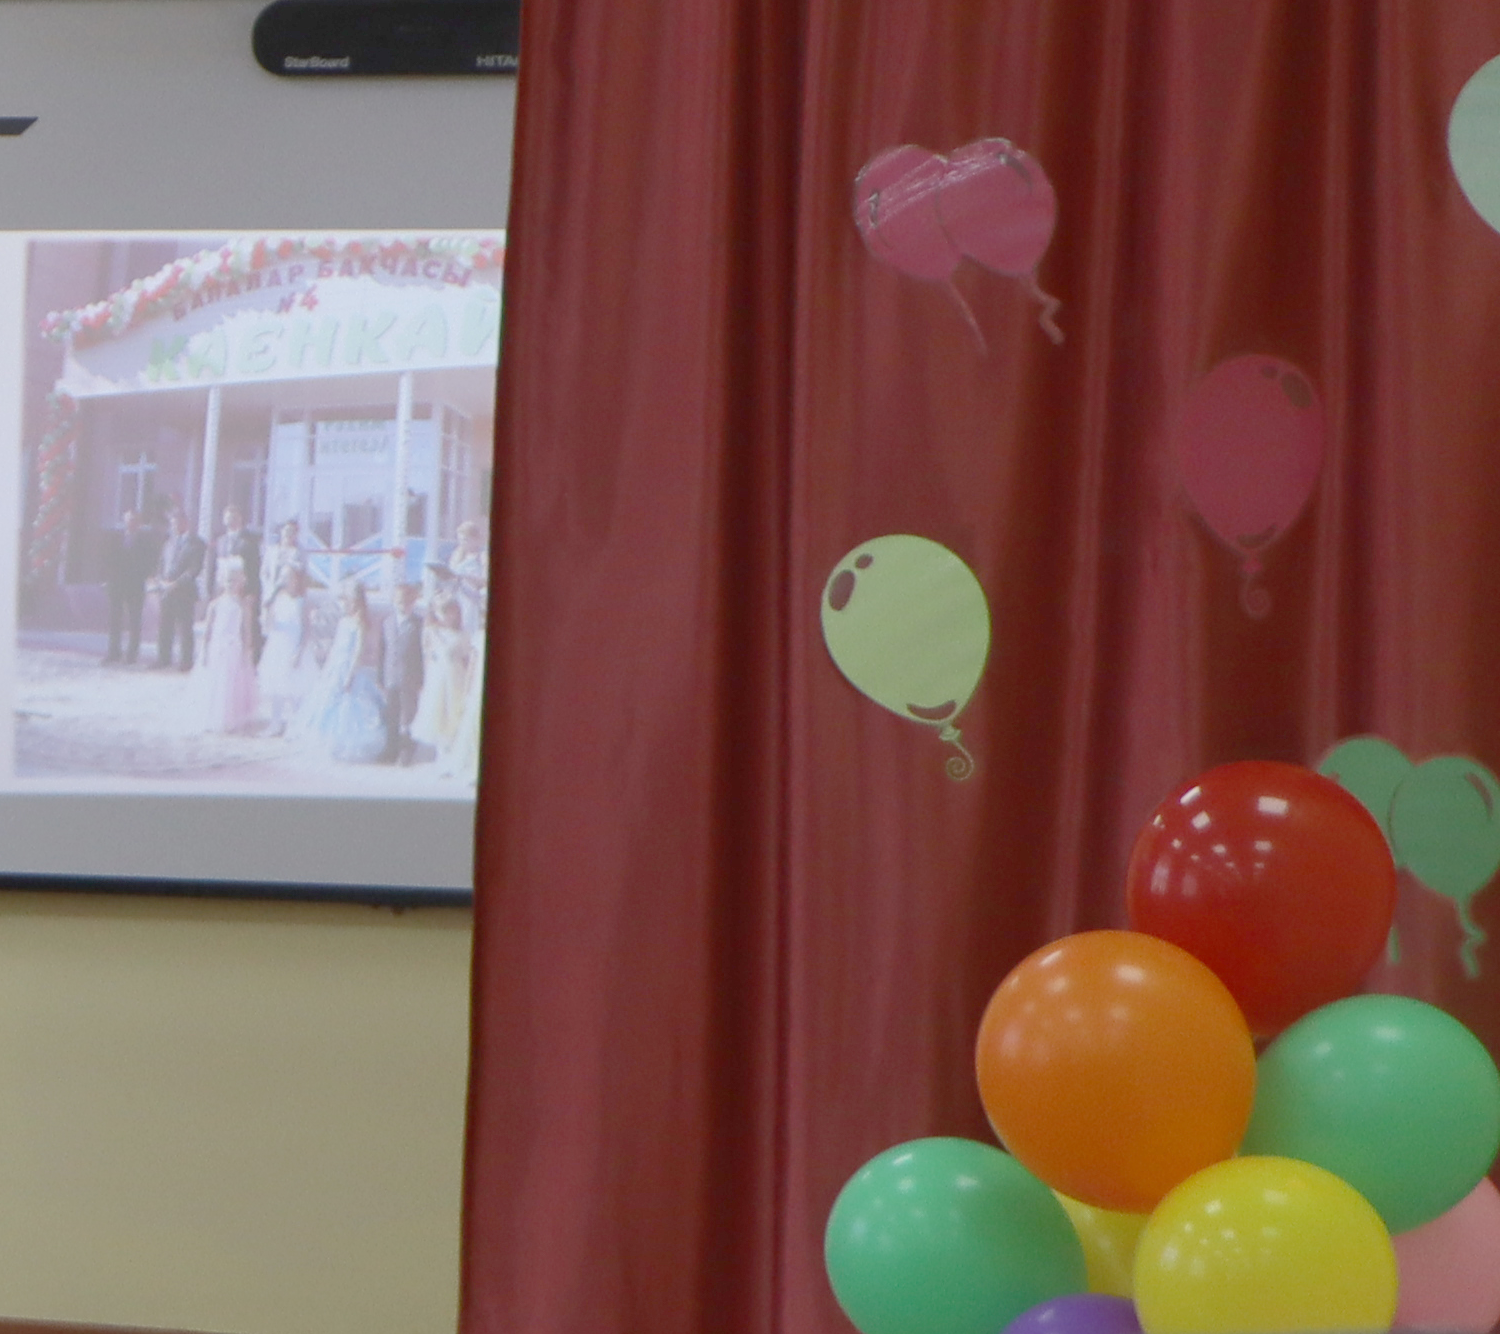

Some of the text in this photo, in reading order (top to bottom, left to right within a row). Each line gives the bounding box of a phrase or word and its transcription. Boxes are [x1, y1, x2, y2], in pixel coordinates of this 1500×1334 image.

[283, 54, 519, 69] StarBoard HITA
[318, 250, 473, 288] БАКЧАСЫ
